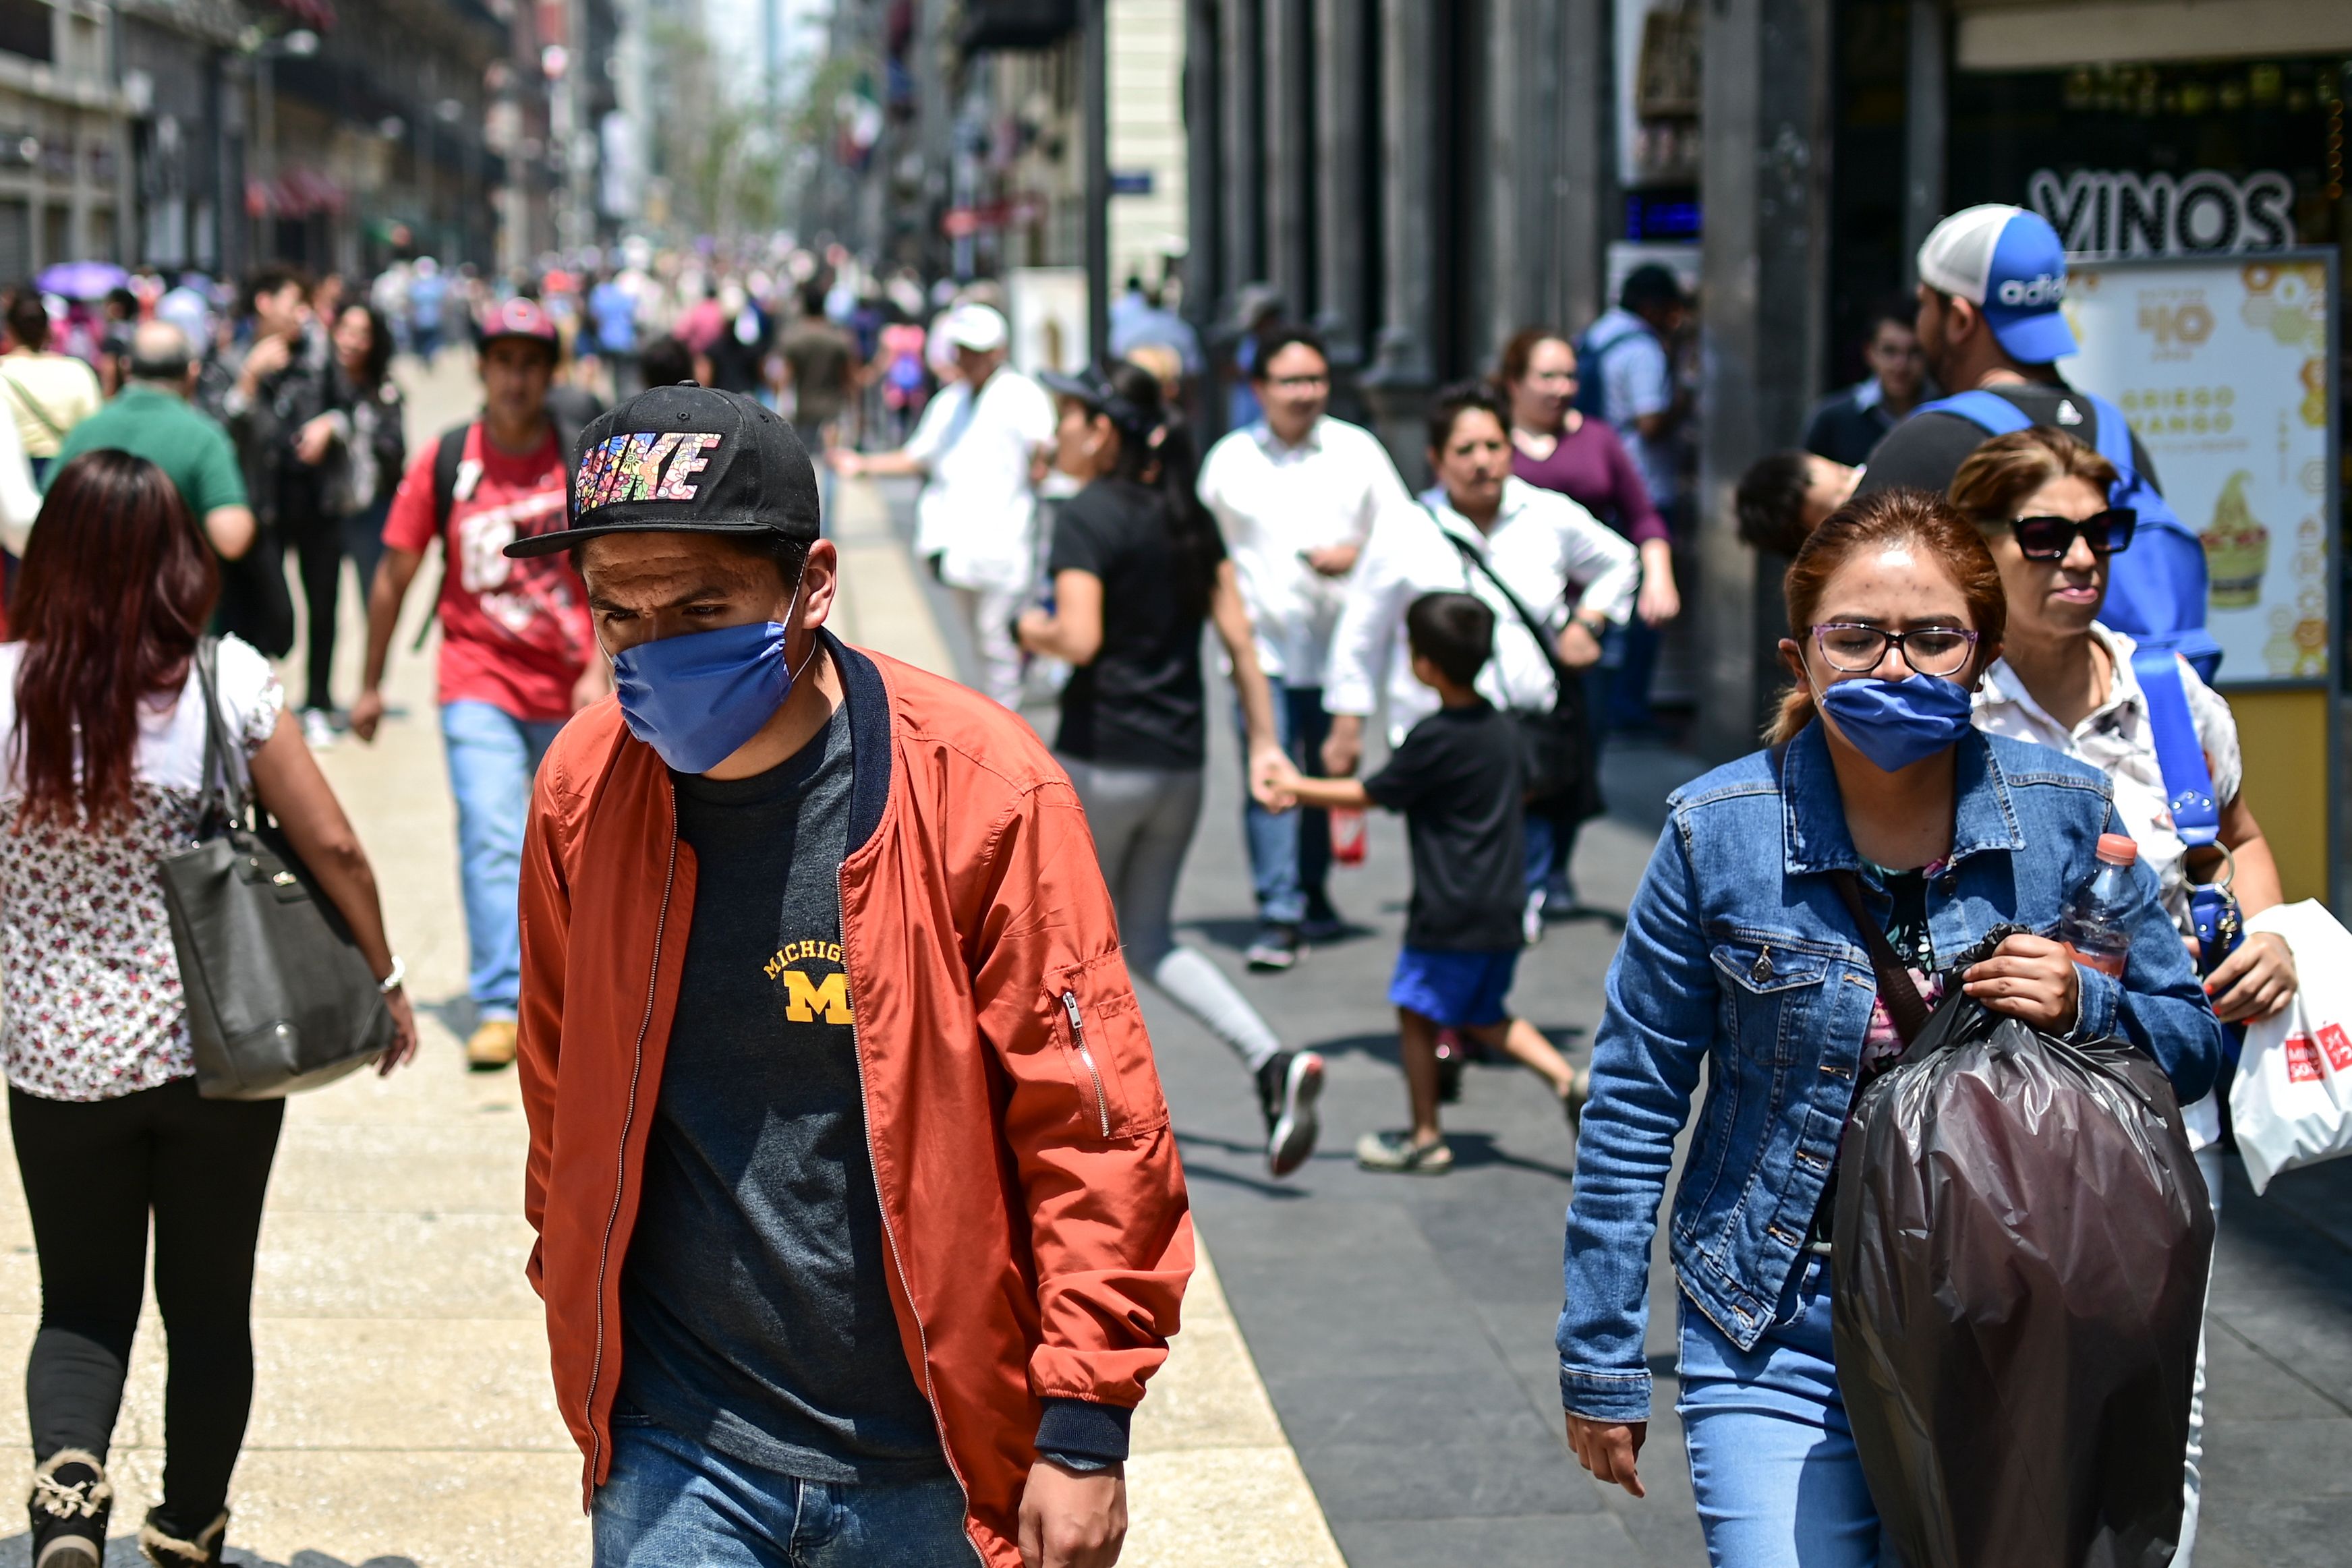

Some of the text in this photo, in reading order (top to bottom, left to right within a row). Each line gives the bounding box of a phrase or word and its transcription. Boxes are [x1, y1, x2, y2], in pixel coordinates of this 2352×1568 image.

[2030, 170, 2295, 254] VINOS
[1999, 272, 2069, 307] adid
[574, 432, 722, 517] NIKE
[764, 940, 843, 980] MICHIG
[783, 970, 854, 1024] M
